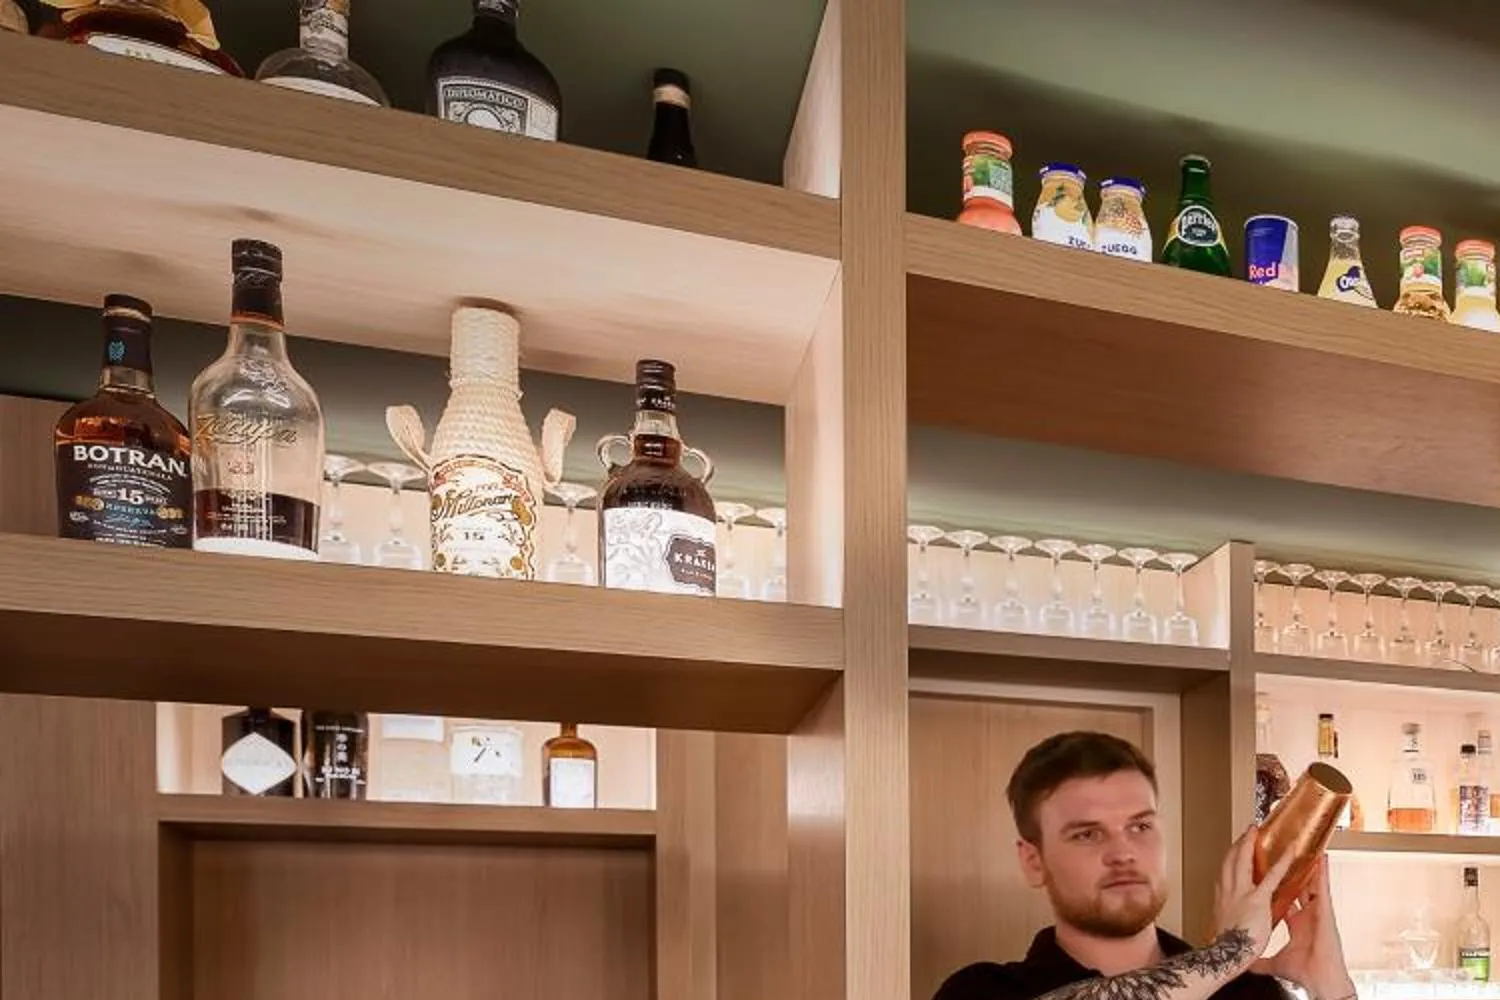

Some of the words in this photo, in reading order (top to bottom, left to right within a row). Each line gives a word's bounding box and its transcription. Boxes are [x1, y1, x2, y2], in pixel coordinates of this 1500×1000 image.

[1249, 261, 1277, 280] Red
[73, 445, 187, 478] BOTRAN
[118, 488, 144, 505] 15
